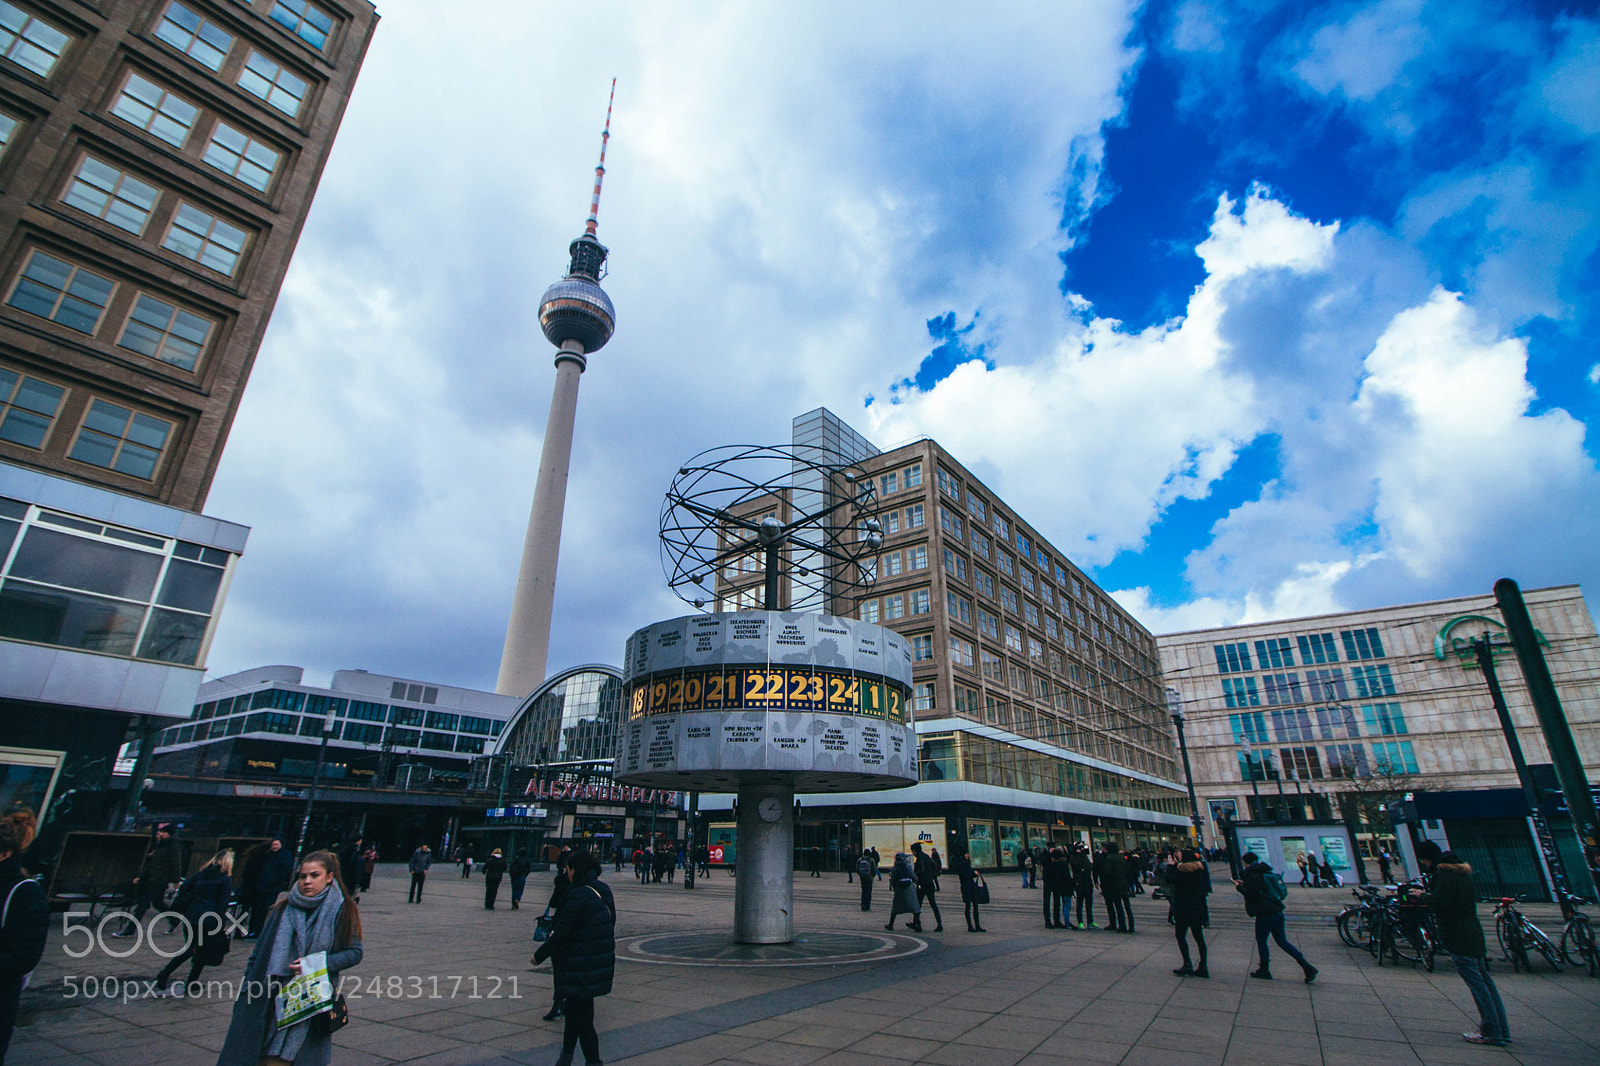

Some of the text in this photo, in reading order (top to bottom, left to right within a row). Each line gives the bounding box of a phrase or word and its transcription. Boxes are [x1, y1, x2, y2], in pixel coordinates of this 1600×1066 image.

[632, 674, 899, 715] 18 19 20 21 22 23 24 1 2
[525, 778, 676, 805] ALEXANDERPLATZ
[918, 831, 931, 840] dm
